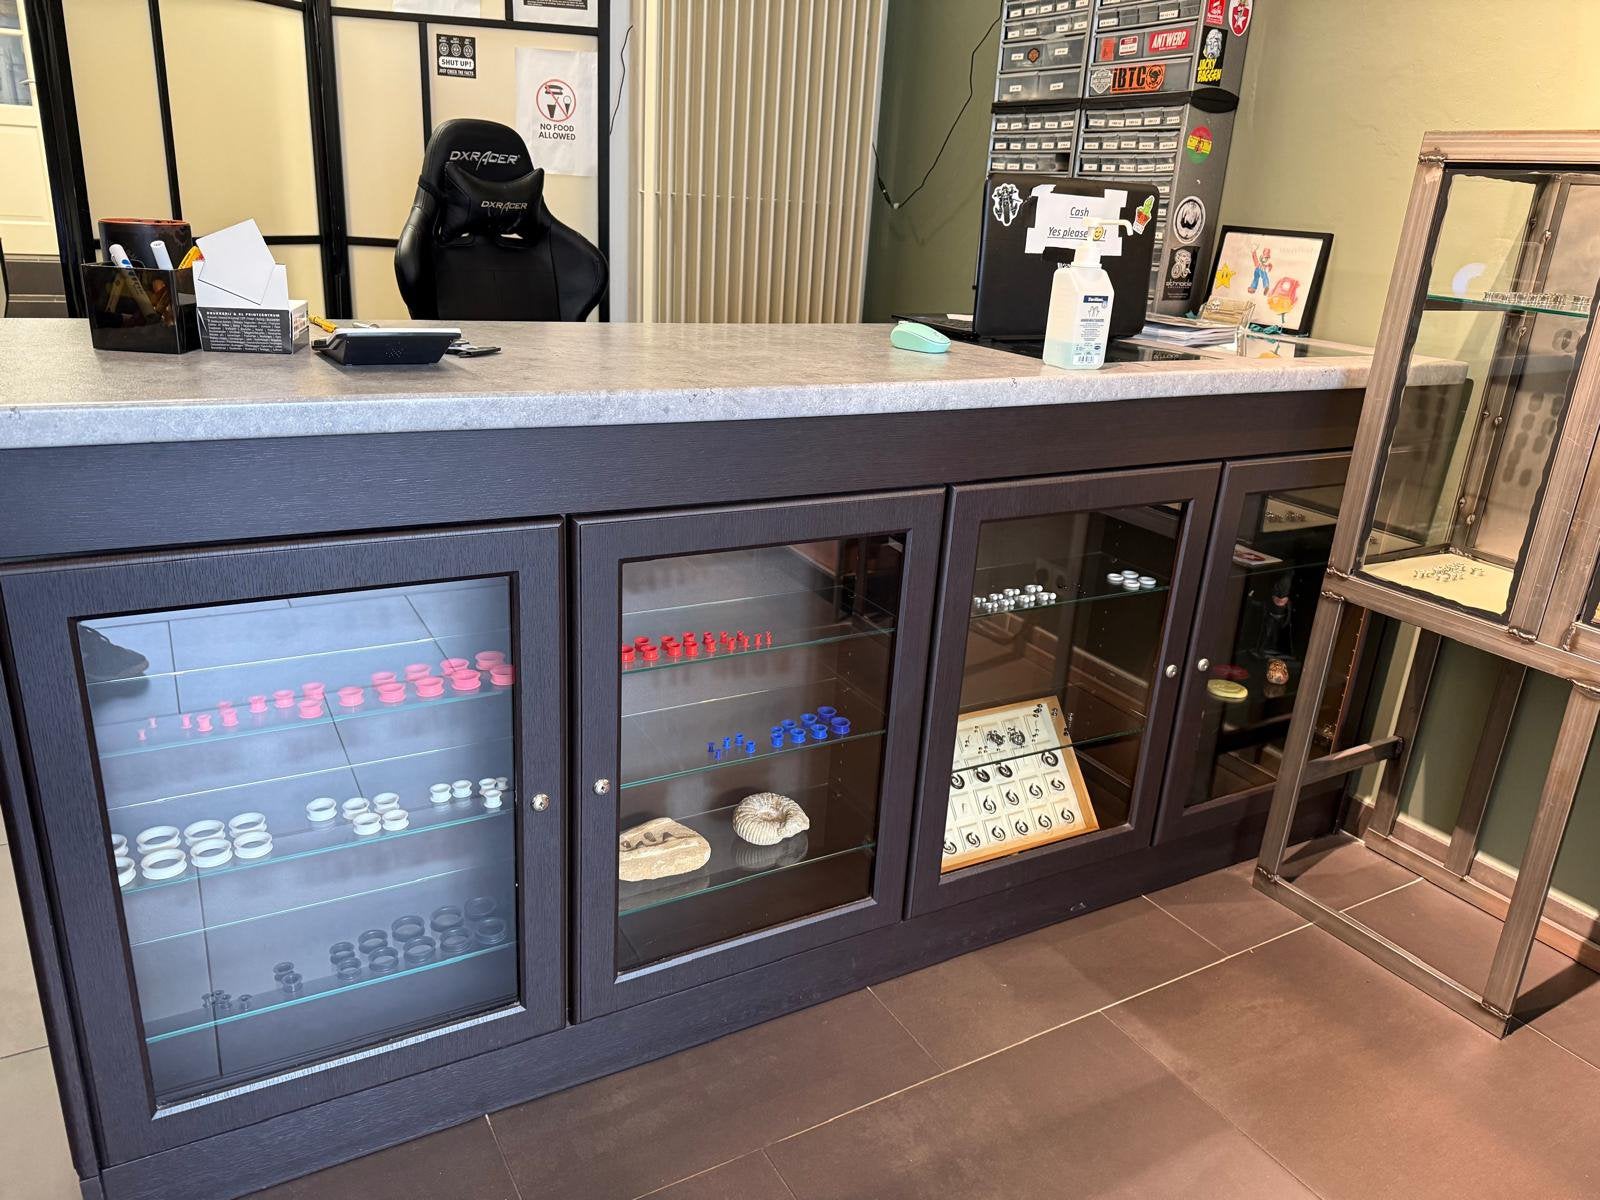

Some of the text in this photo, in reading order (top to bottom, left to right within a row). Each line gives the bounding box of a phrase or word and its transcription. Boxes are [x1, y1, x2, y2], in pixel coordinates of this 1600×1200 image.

[540, 123, 575, 132] NO FOOD
[538, 131, 576, 140] ALLOWED
[449, 150, 518, 170] DXRACER
[480, 200, 528, 214] DXRACER
[1070, 206, 1090, 217] Cash
[1048, 226, 1061, 237] Yes
[1062, 226, 1089, 239] please
